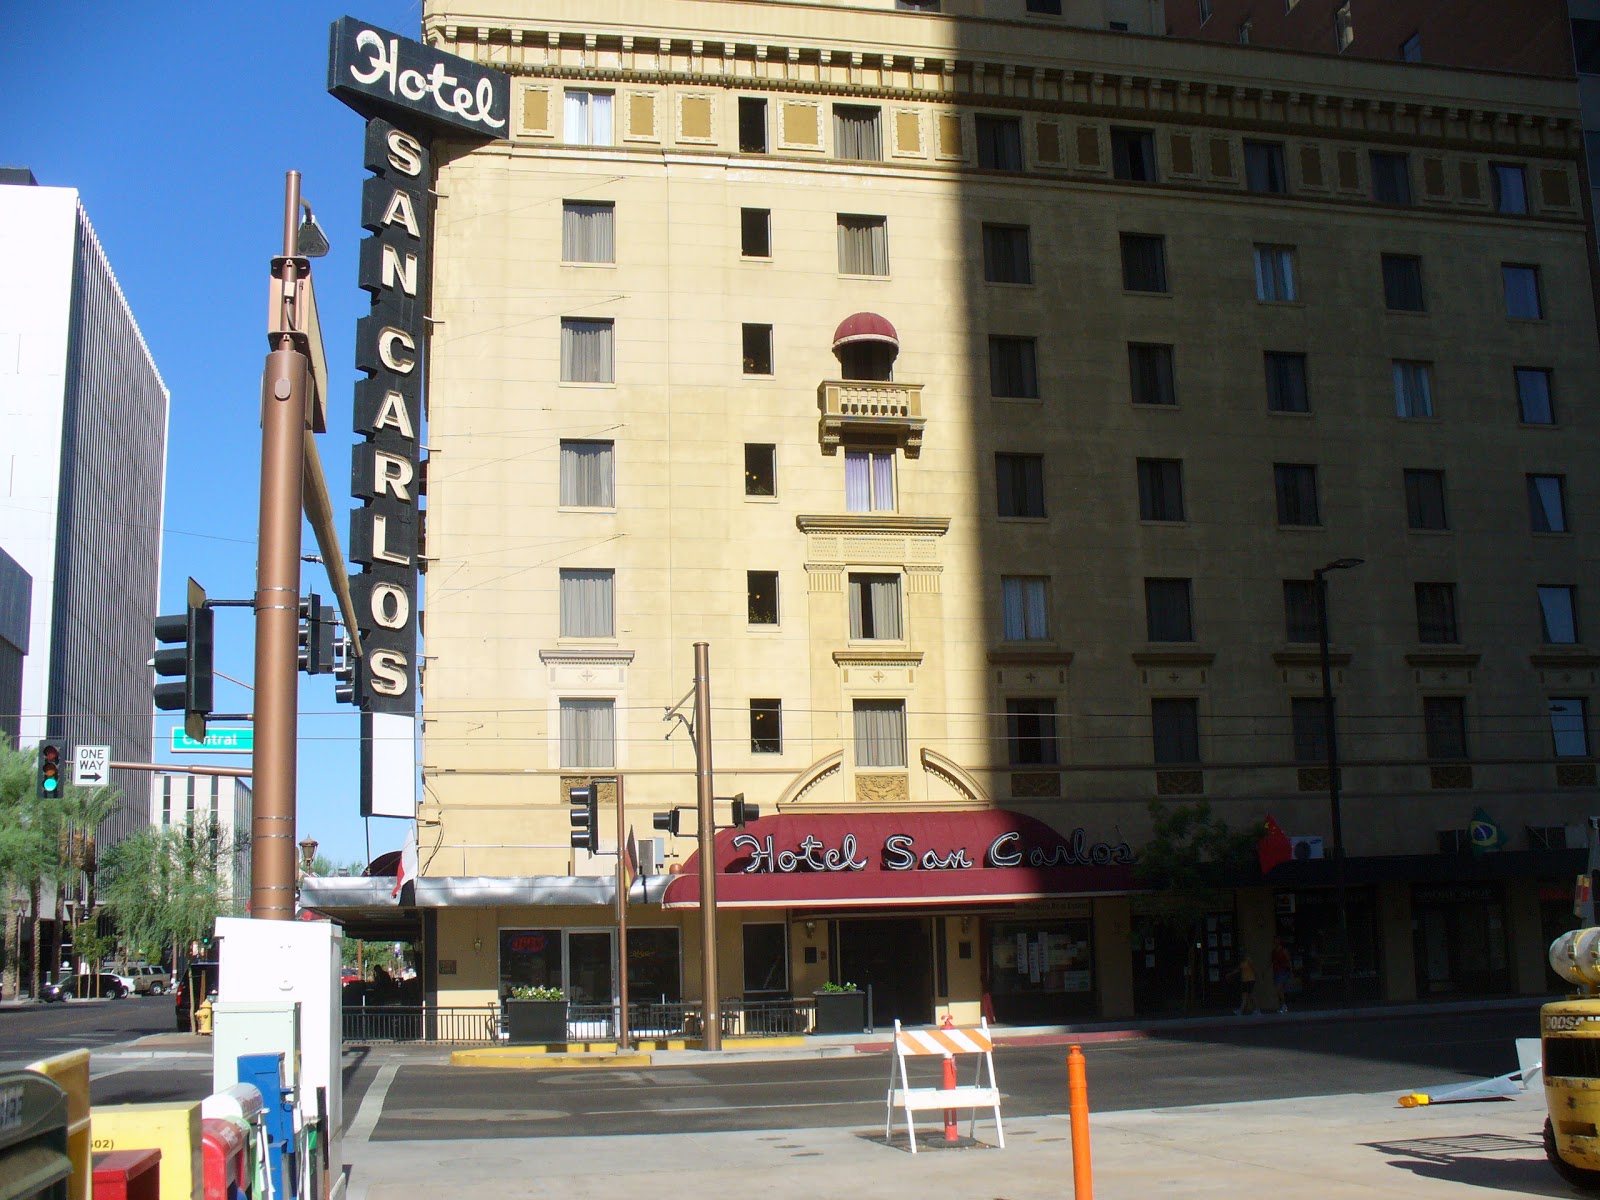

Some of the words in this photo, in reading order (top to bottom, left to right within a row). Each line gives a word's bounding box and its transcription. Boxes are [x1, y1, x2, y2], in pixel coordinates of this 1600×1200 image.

[350, 29, 505, 128] Hotel
[380, 129, 421, 298] SAN
[369, 326, 415, 697] CARLOS
[79, 759, 104, 770] WAY
[81, 748, 104, 759] ONE
[733, 833, 868, 873] Hotel
[884, 834, 974, 871] San
[986, 831, 1140, 867] Carlos
